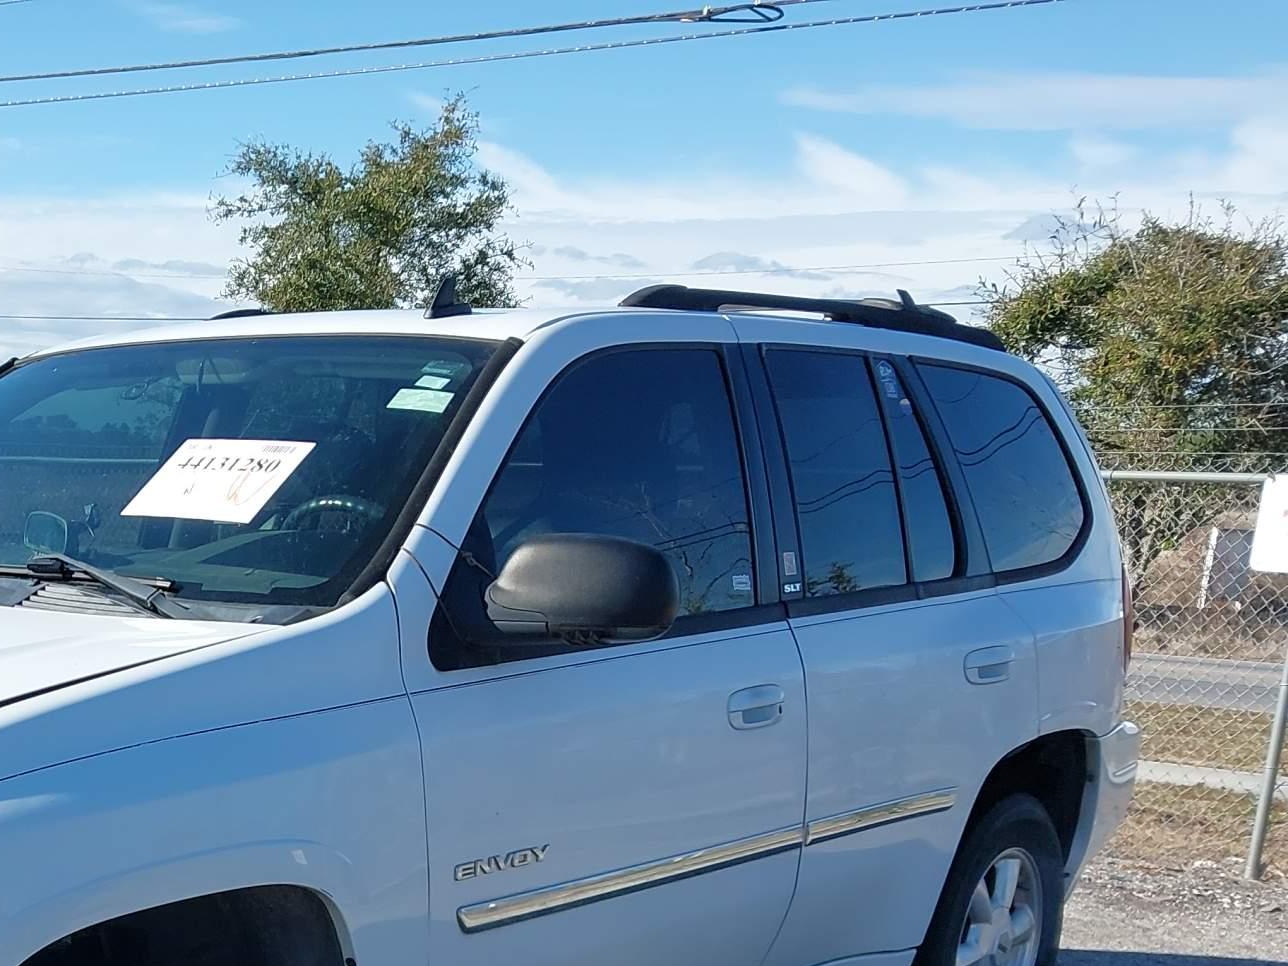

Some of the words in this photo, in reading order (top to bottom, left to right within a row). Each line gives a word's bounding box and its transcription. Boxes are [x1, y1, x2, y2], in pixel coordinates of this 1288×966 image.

[178, 456, 282, 473] 44131280
[784, 583, 801, 593] SLT
[454, 843, 550, 881] ENVOY
